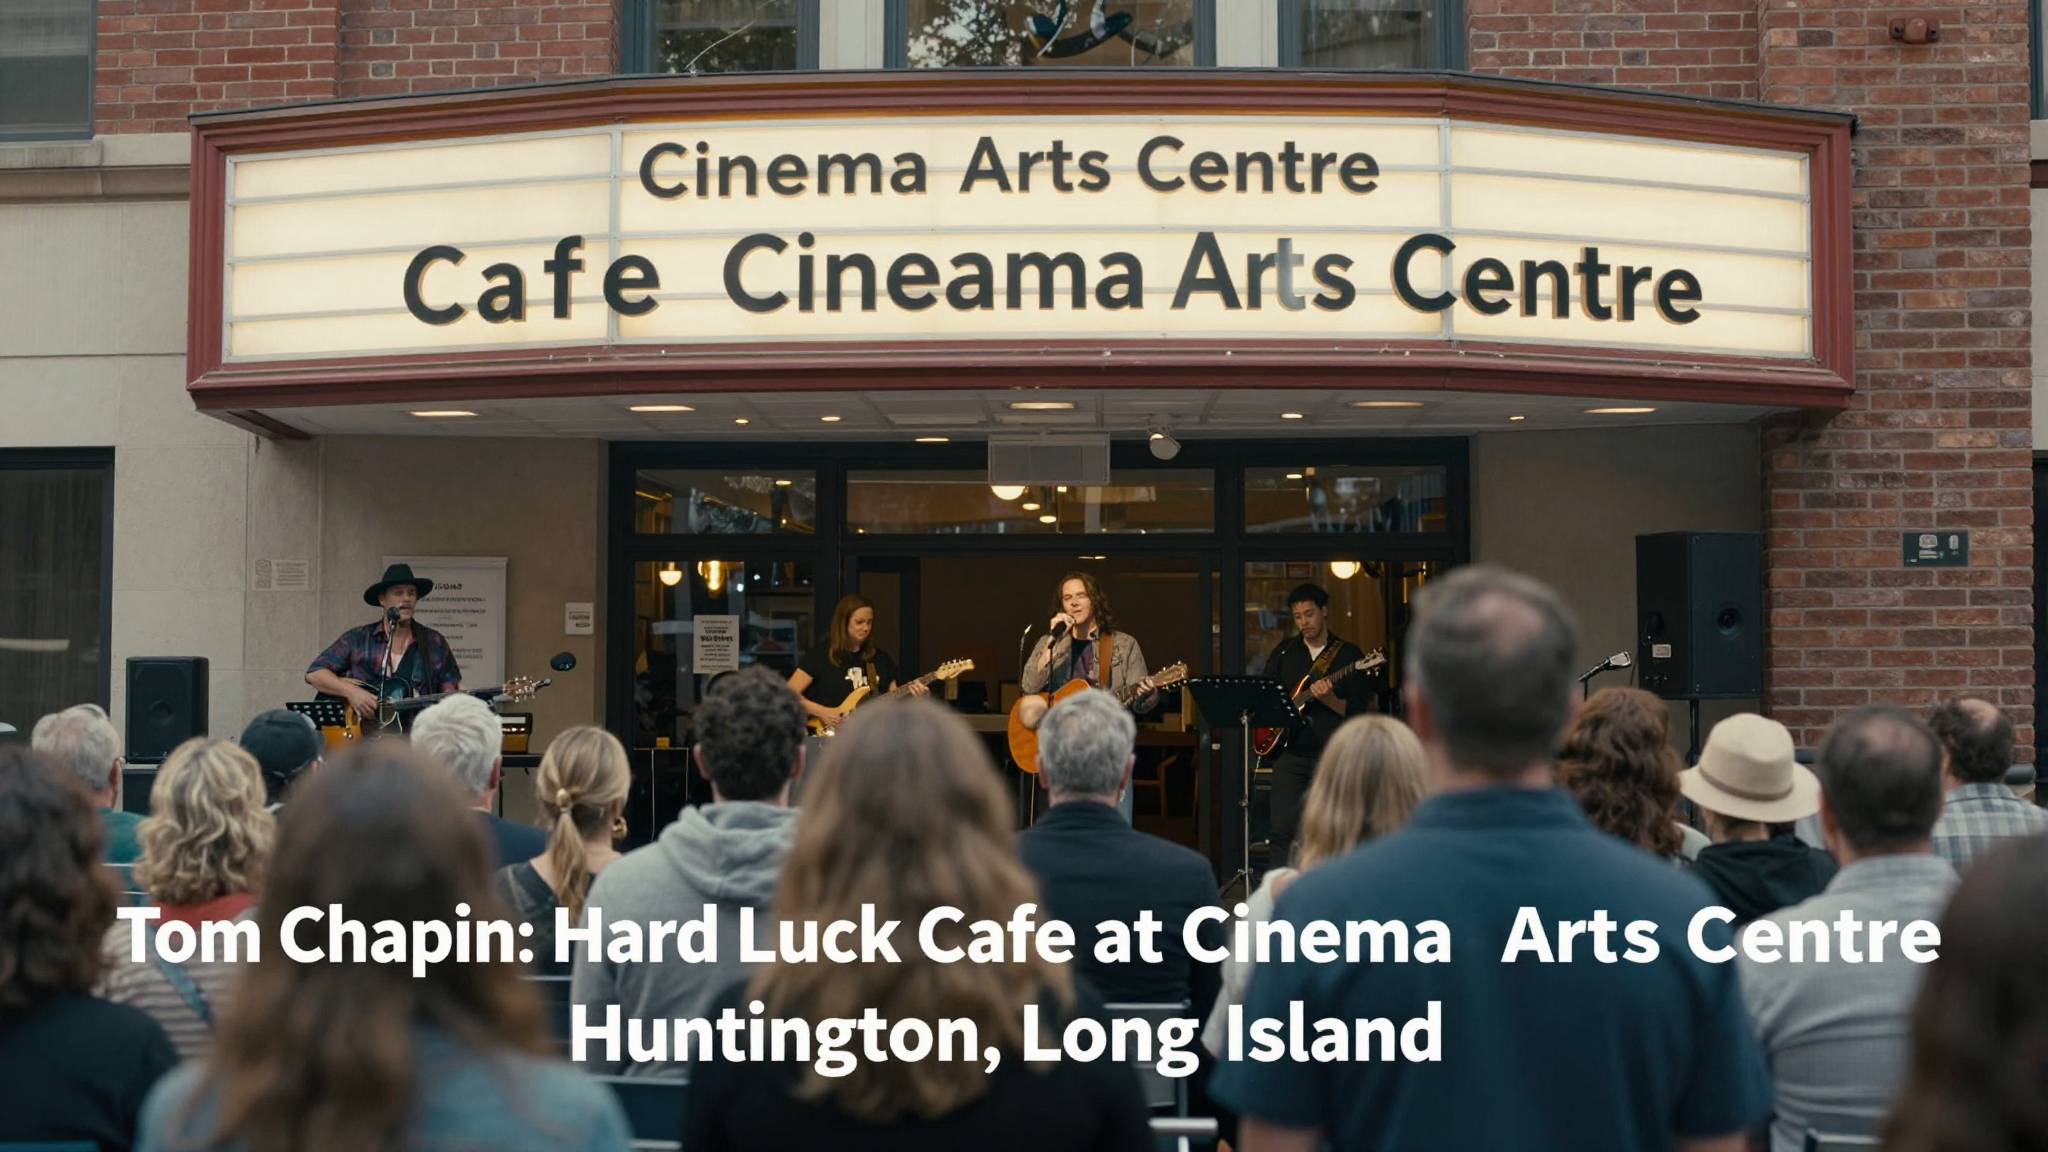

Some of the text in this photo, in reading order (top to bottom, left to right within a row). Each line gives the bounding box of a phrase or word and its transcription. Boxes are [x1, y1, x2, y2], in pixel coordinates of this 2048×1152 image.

[639, 136, 1380, 199] Cinema Arts Centre
[403, 231, 1704, 326] Cafe Cineama Arts Centre
